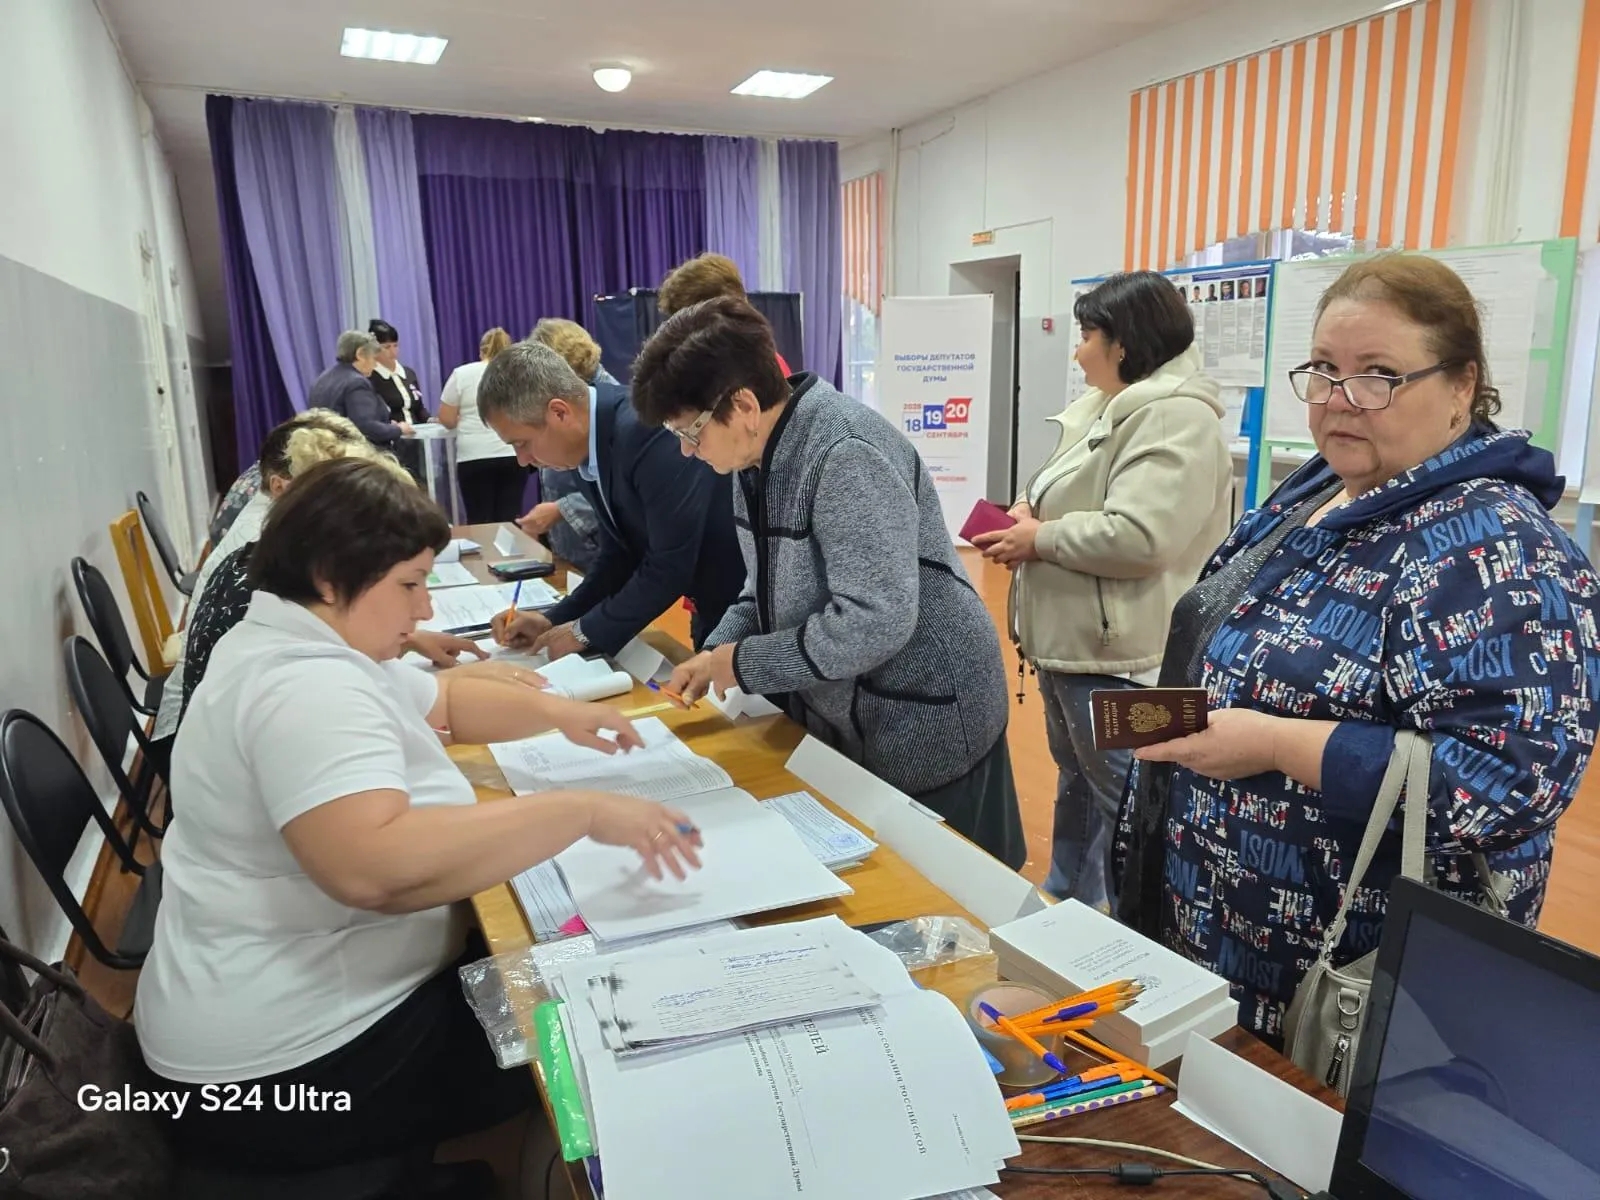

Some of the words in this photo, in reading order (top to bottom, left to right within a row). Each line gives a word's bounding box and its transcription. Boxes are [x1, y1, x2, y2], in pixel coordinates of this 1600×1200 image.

[929, 353, 976, 361] ДЕПУТАТОВ
[897, 363, 974, 372] ГОСУДАРСТВЕННОЙ
[922, 375, 947, 383] ДУМЫ
[925, 410, 942, 425] 19
[945, 403, 967, 418] 20
[905, 419, 921, 432] 18
[1182, 697, 1197, 732] АСПОРТ
[880, 1037, 903, 1082] СОБРАНИЯ
[899, 1084, 927, 1156] РОССИЙСКОЙ
[776, 1101, 799, 1167] Государственной
[791, 1168, 803, 1192] Думы
